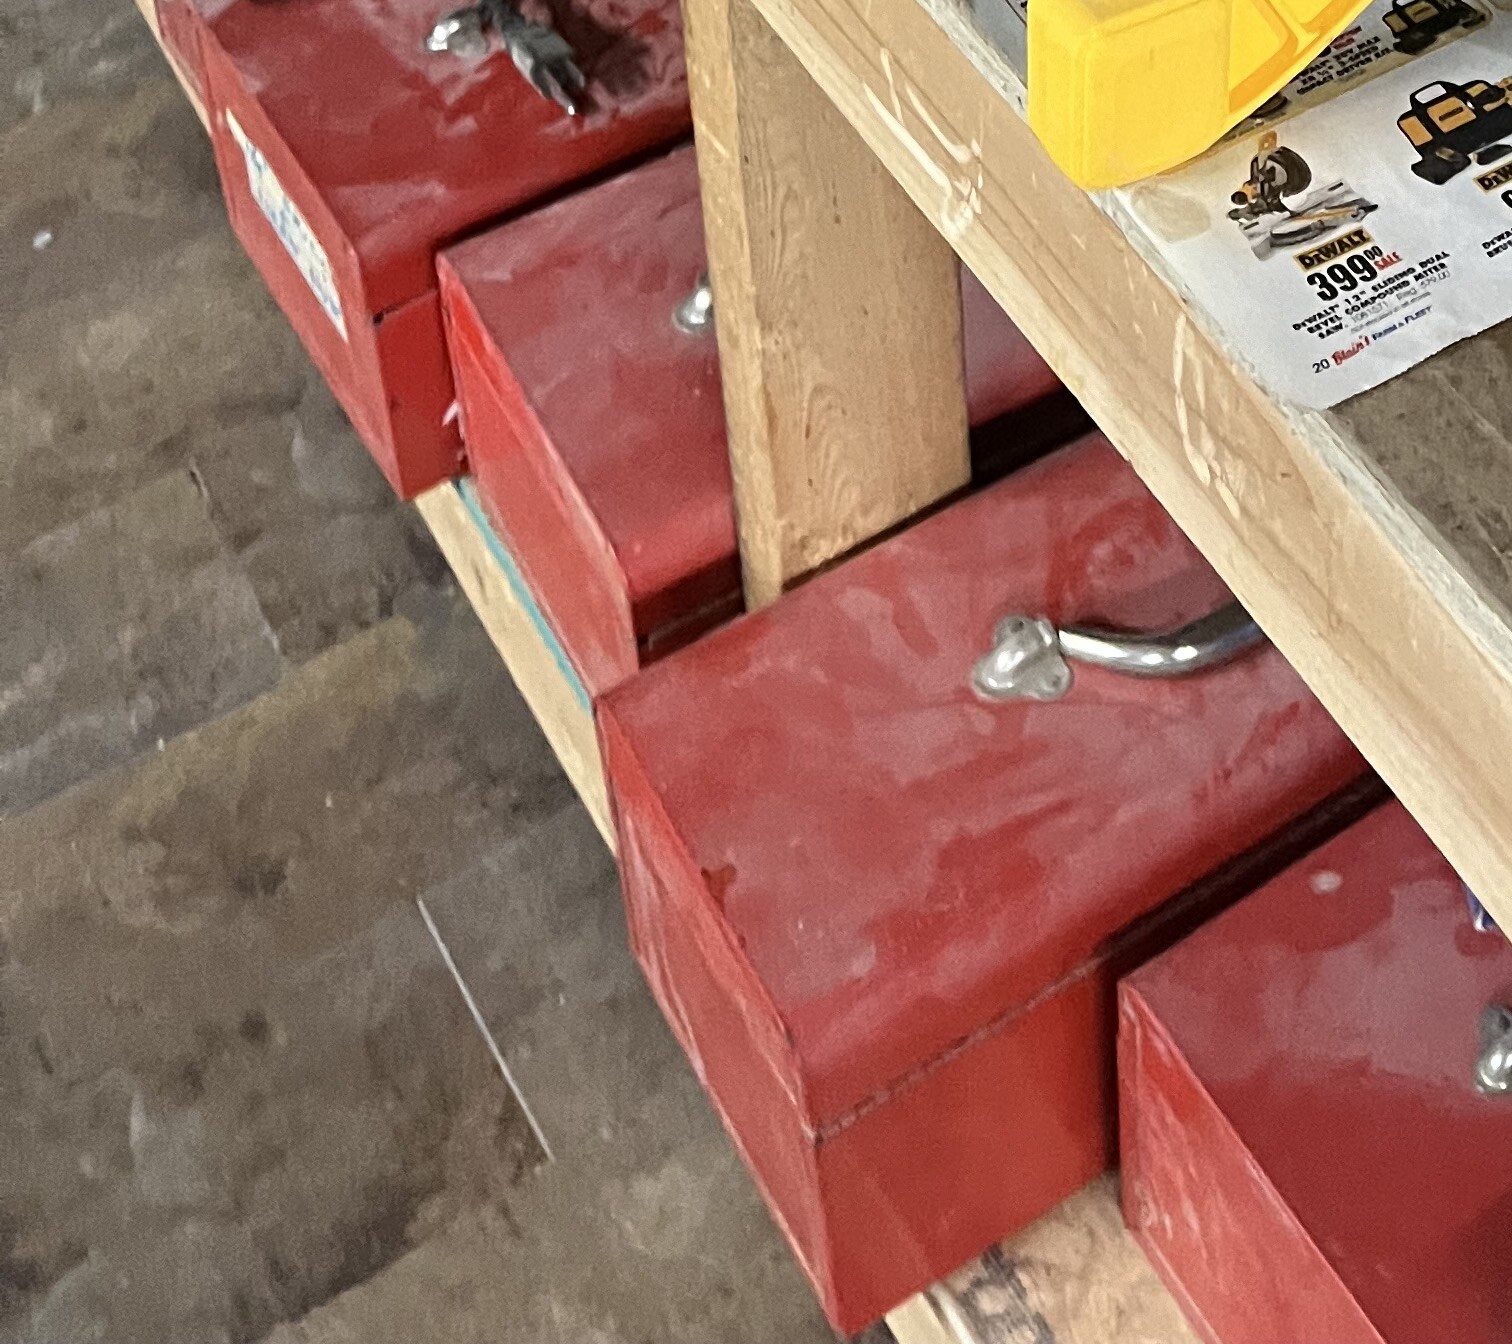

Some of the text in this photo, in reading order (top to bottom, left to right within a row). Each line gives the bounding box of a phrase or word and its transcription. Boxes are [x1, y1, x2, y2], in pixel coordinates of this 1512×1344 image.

[1306, 254, 1378, 301] 399
[1374, 251, 1403, 271] SALE
[1371, 267, 1416, 292] SLIDING
[1418, 251, 1450, 268] DUAL
[1307, 314, 1343, 334] BEVEL
[1344, 280, 1411, 315] COMPOUND
[1413, 262, 1448, 282] MITER
[1312, 359, 1331, 374] 20
